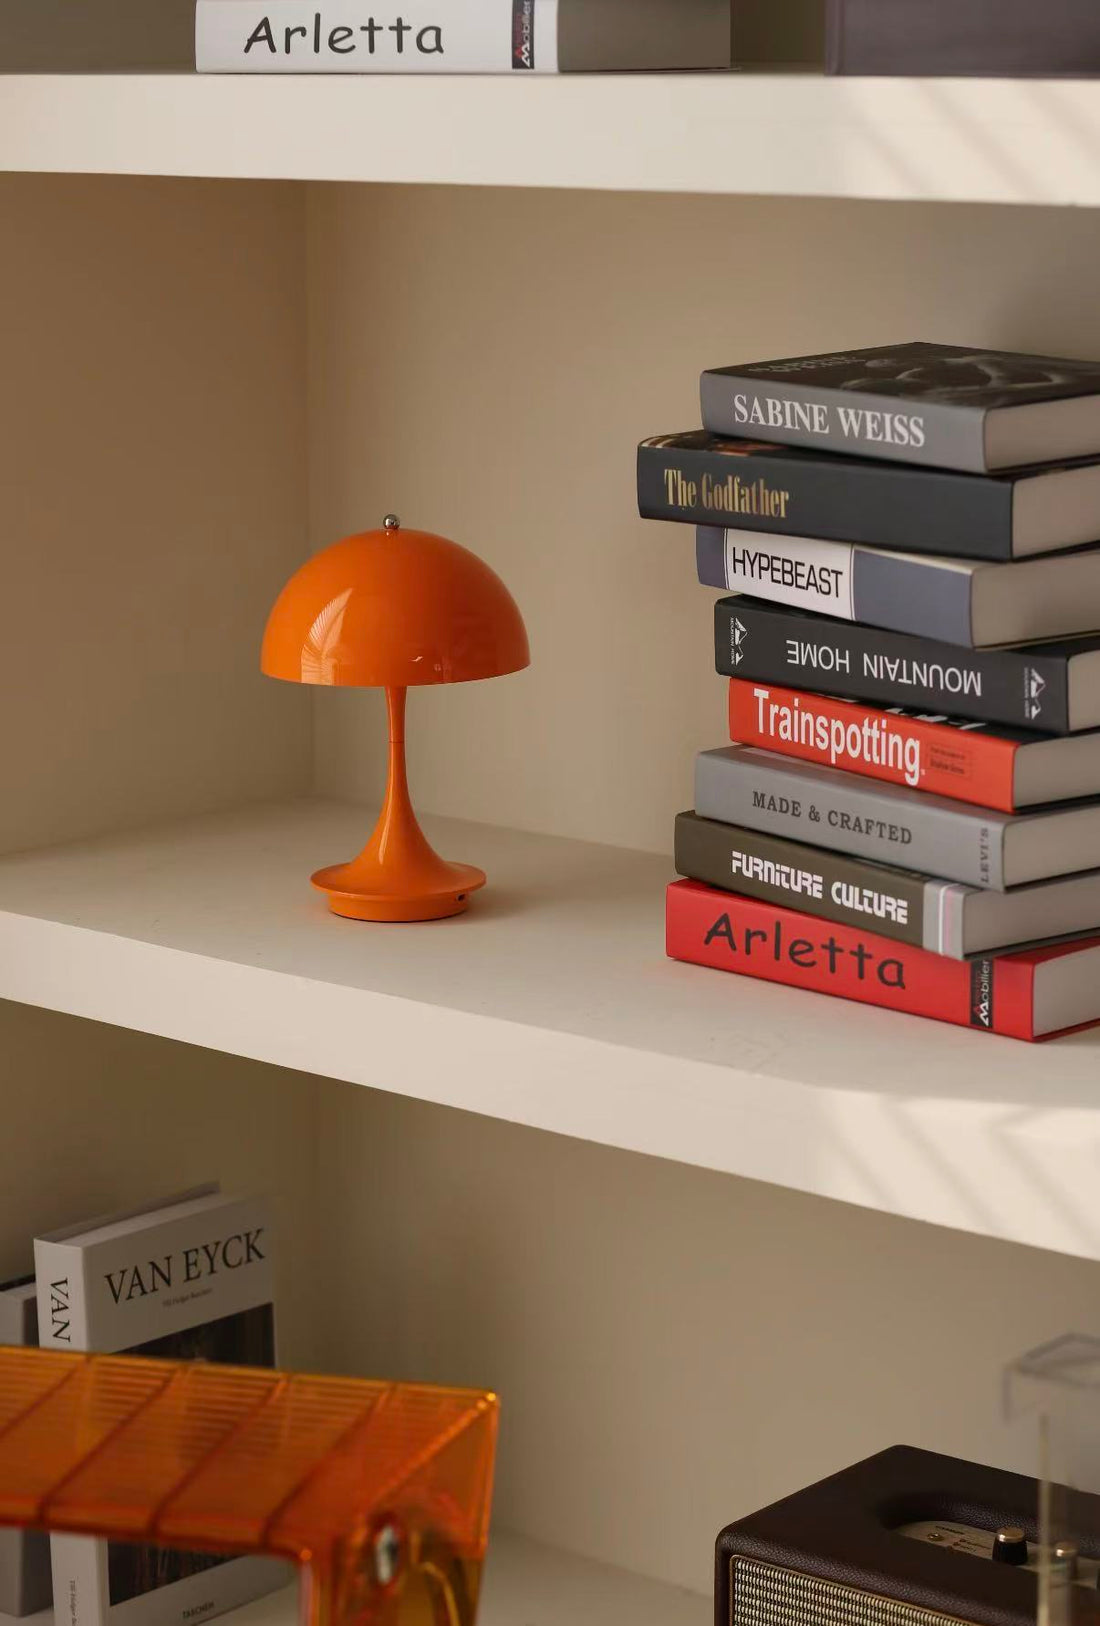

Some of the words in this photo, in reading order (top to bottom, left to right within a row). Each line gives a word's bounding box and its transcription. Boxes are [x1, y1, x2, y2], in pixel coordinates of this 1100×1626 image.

[243, 12, 444, 55] Arletta
[733, 394, 830, 435] SABINE
[837, 407, 925, 447] WEISS
[664, 468, 697, 508] The
[702, 474, 790, 518] Godfather
[732, 546, 843, 599] HYPEBEAST
[786, 639, 850, 674] HOME
[863, 652, 982, 697] MOUNTAIN
[752, 790, 802, 818] MADE
[808, 804, 821, 822] &
[827, 809, 913, 845] CRAFTED
[979, 827, 990, 884] LEVI'S
[731, 850, 823, 899] FURNITURE
[830, 881, 909, 925] CULTURE
[704, 912, 906, 990] Arletta
[979, 960, 991, 1027] Mobilier
[103, 1256, 173, 1305] VAN
[182, 1228, 266, 1283] EYCK
[50, 1277, 71, 1343] VAN
